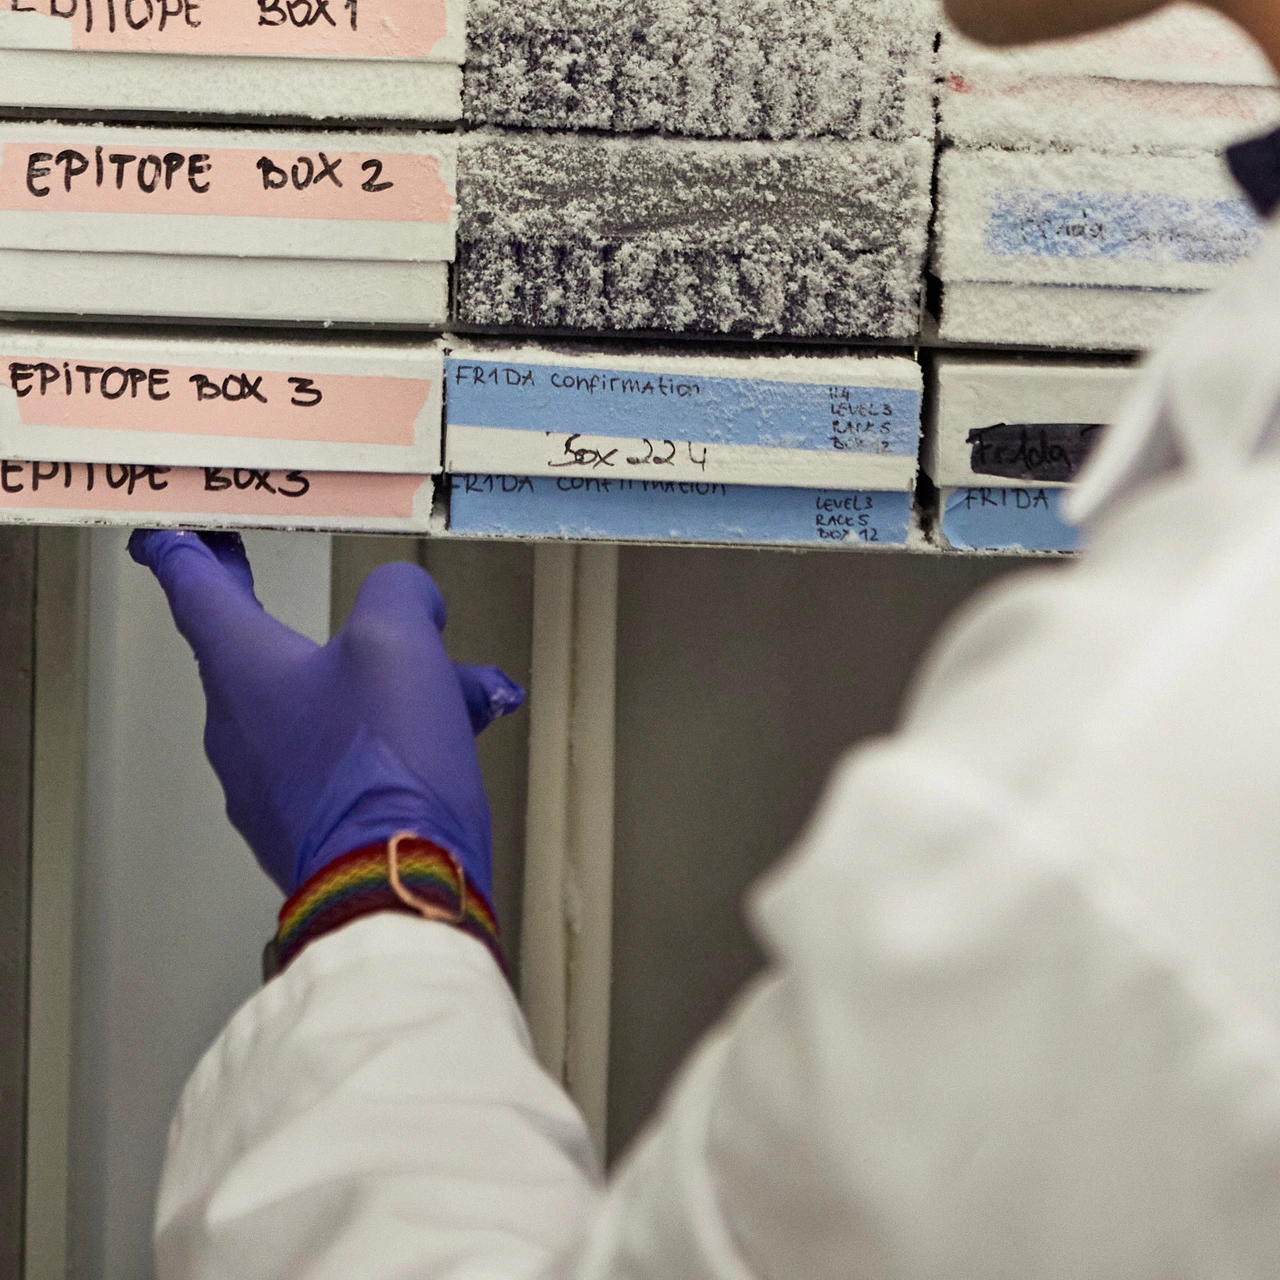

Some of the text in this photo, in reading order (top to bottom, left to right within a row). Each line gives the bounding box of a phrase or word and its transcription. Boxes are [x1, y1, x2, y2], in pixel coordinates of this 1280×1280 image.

[255, 151, 344, 190] BOX
[360, 158, 395, 192] 2
[188, 373, 268, 404] BOX
[288, 376, 323, 407] 3
[830, 402, 893, 418] LEVEL 3
[815, 495, 874, 512] LEVEL 3
[815, 513, 870, 527] RACK 5
[858, 527, 880, 542] 12
